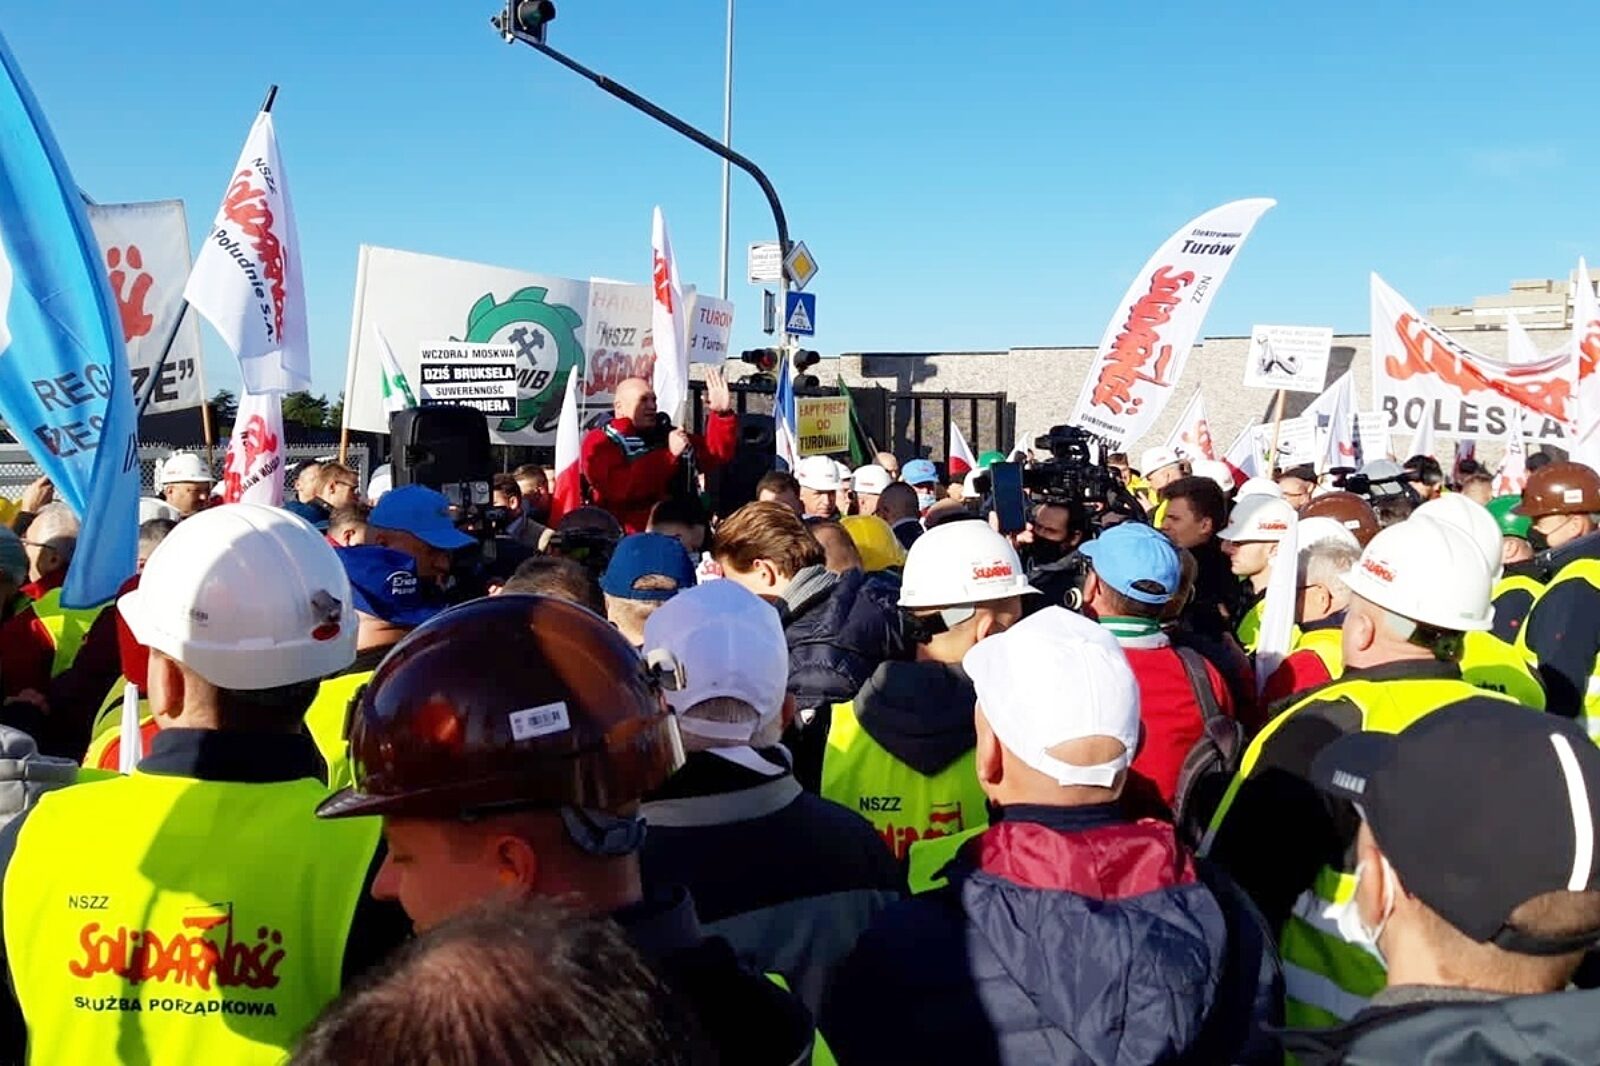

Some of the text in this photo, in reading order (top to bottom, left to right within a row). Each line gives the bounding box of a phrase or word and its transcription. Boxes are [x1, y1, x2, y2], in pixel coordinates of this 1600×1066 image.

[1181, 239, 1236, 256] Turów
[421, 349, 515, 359] WCZORAJ MOSKWA
[423, 364, 514, 380] DZIŚ BRUKSELA
[516, 368, 550, 389] WB
[816, 419, 832, 431] OD
[860, 796, 902, 811] NSZZ
[68, 895, 109, 910] NSZZ
[74, 994, 143, 1012] SŁUŻBA
